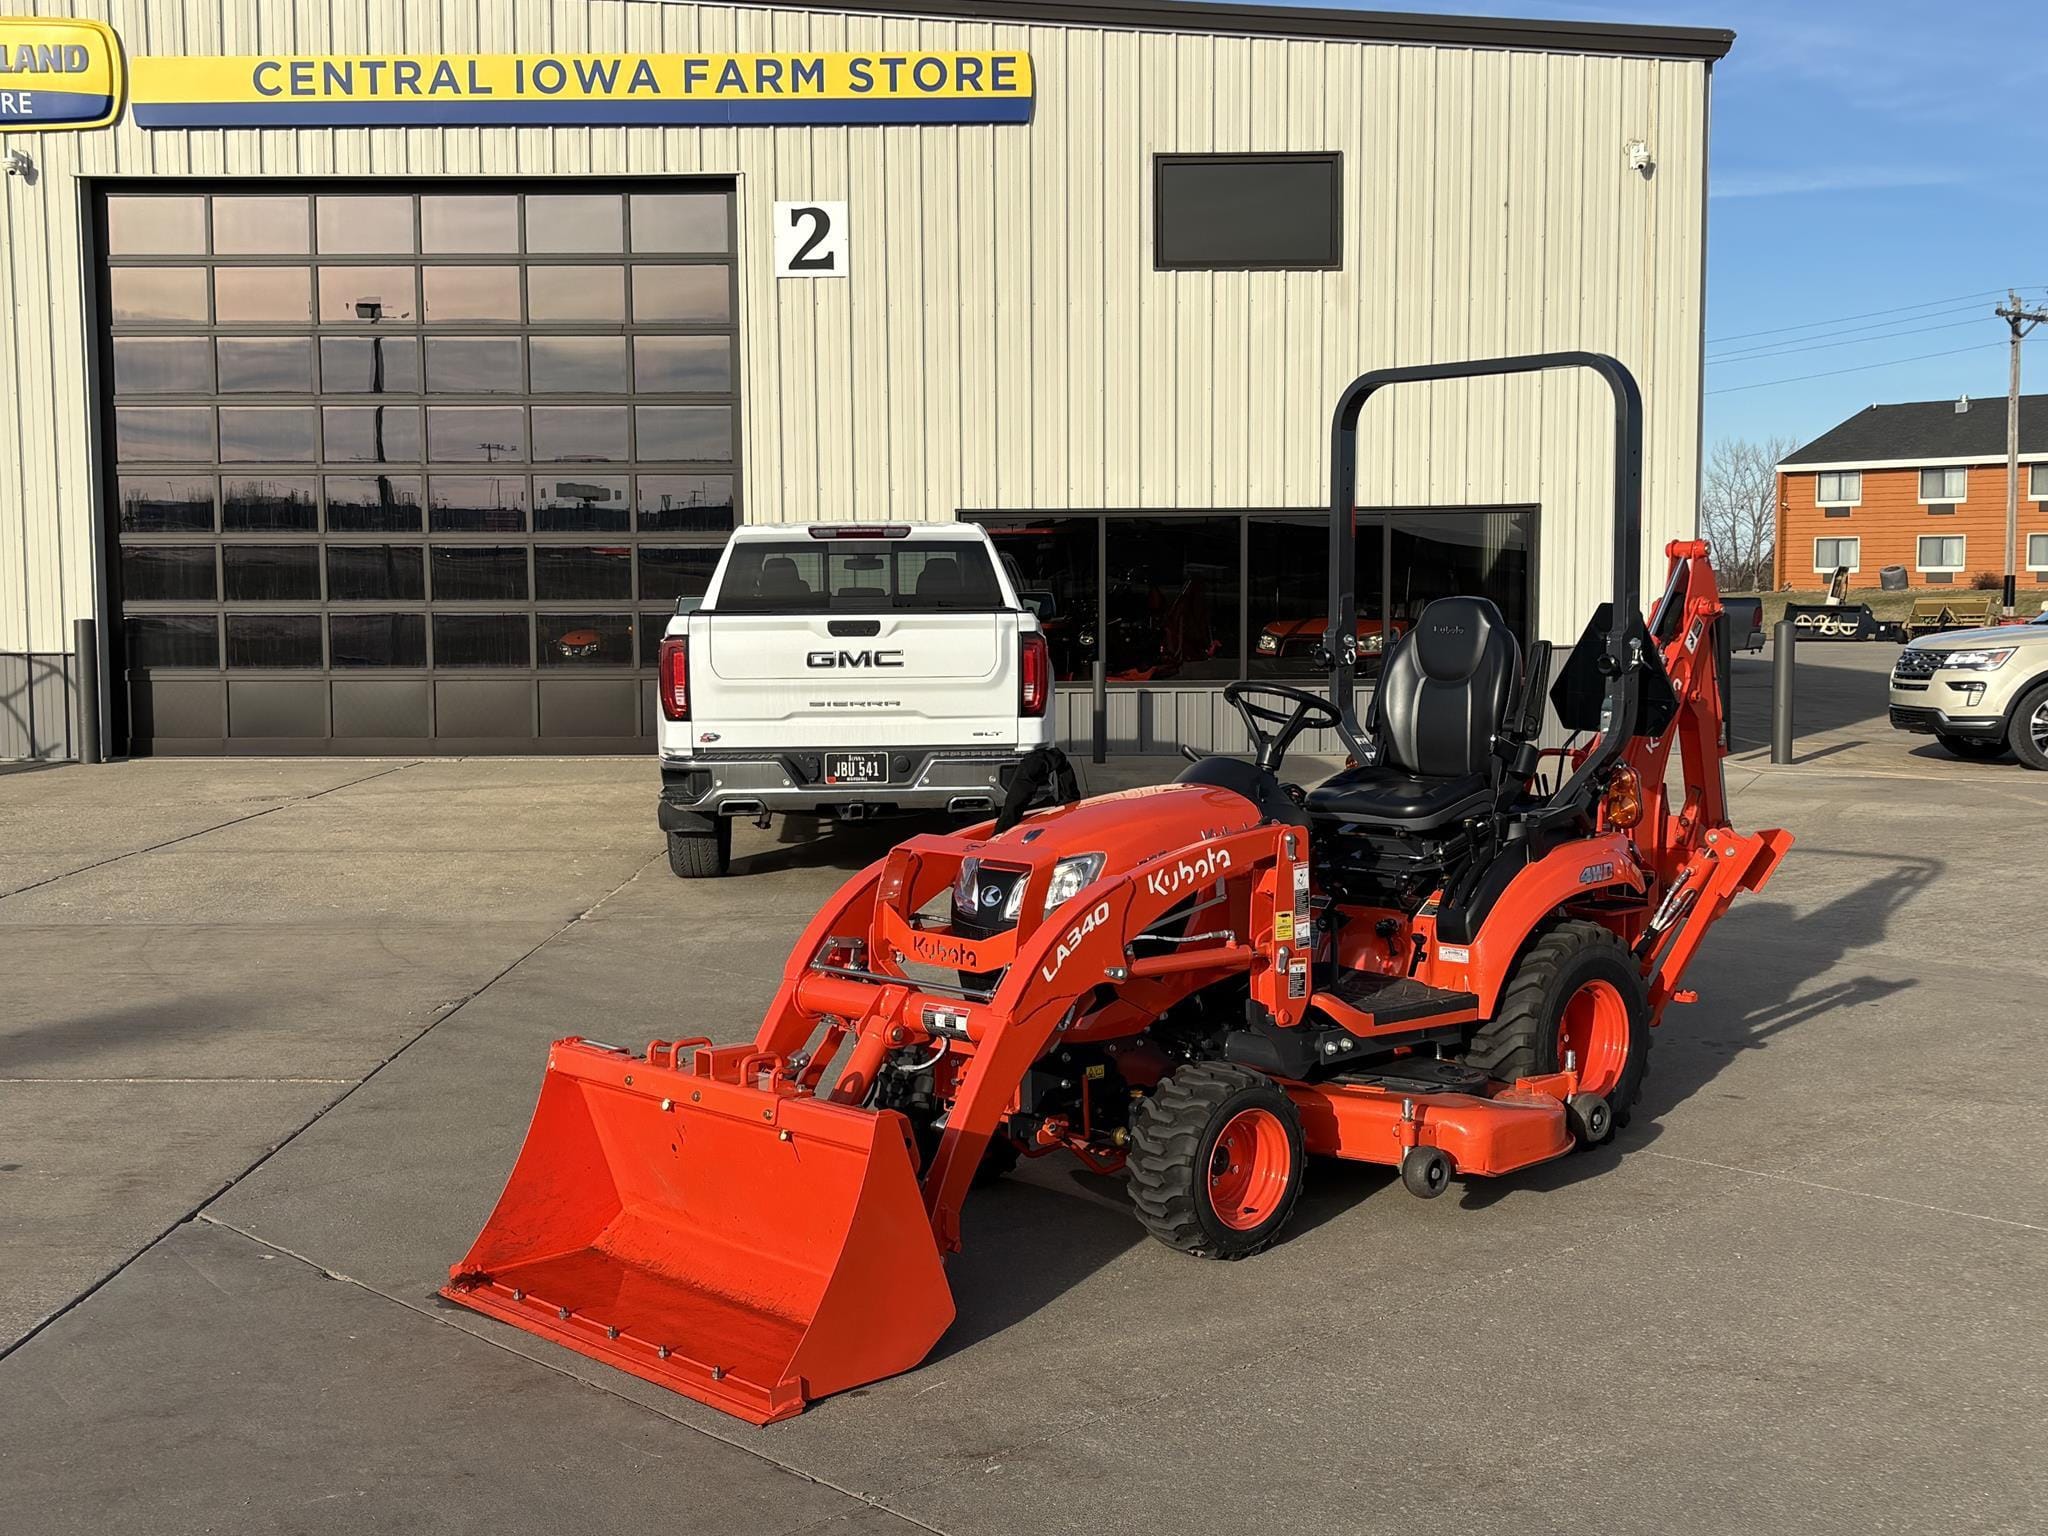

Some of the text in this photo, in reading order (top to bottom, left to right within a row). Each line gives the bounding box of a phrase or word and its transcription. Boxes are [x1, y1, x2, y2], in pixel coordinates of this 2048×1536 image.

[252, 57, 1016, 95] CENTRAL IOWA FARM STORE
[0, 92, 33, 113] RE
[788, 207, 835, 270] 2
[806, 650, 904, 668] GMC
[834, 761, 879, 777] JBU 541
[1147, 847, 1232, 896] Kubota
[913, 936, 977, 967] Kubota
[1042, 902, 1110, 982] LA340
